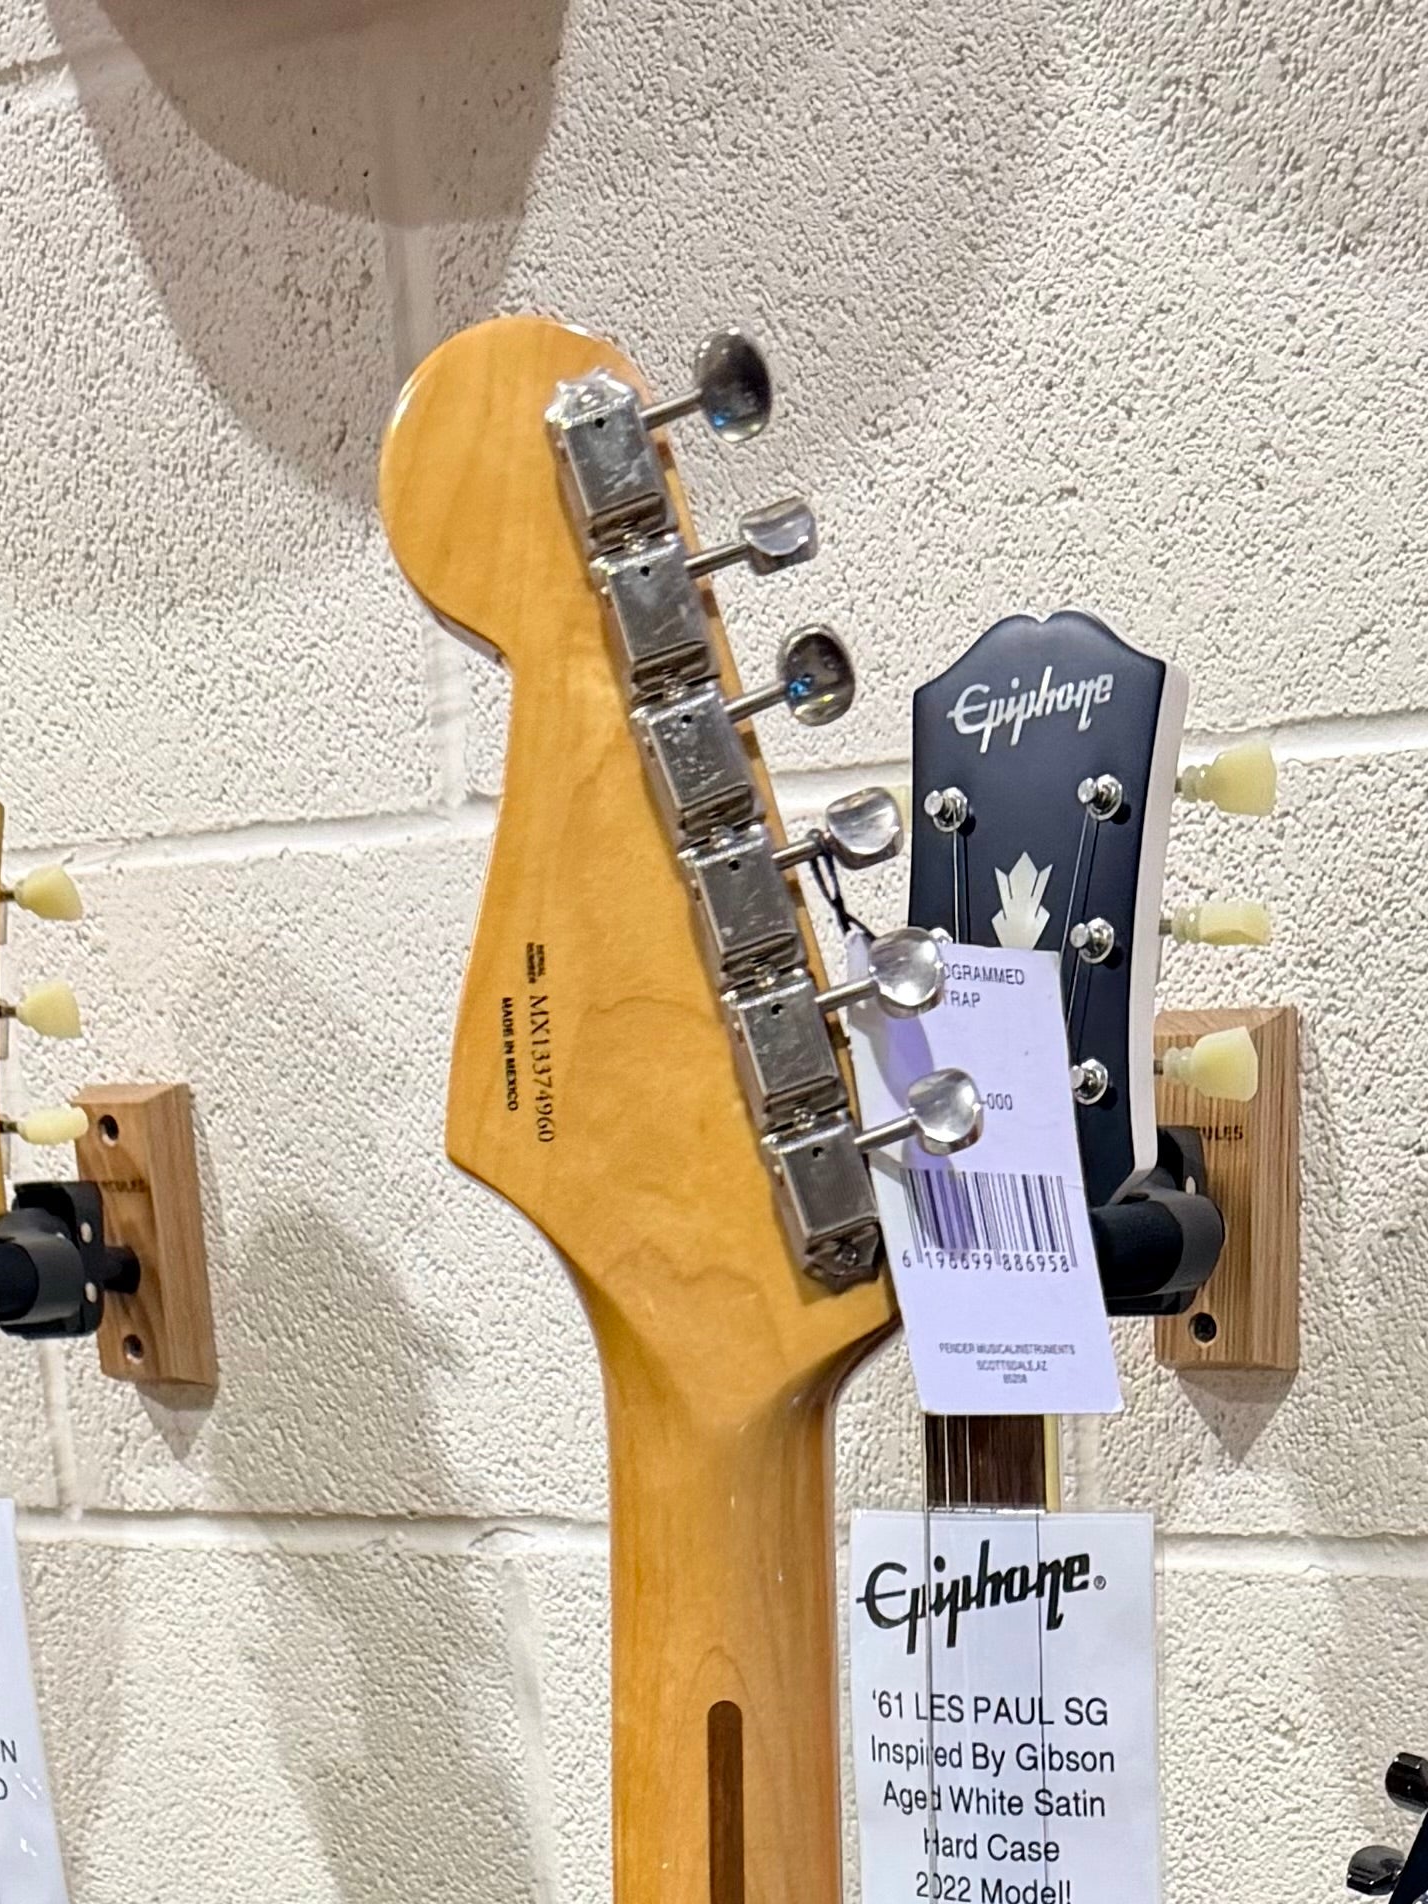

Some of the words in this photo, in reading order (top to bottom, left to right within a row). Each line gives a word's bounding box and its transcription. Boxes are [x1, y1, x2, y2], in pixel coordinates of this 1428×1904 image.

[946, 665, 1114, 754] Epiphone
[502, 997, 514, 1037] MADE
[503, 1041, 515, 1055] IN
[505, 1058, 518, 1112] MEXICO
[529, 995, 555, 1143] MX13374960
[902, 1250, 911, 1268] 6
[915, 1692, 965, 1725] LES
[973, 1695, 1055, 1726] PAUL
[1064, 1697, 1109, 1727] SG
[870, 1735, 964, 1771] Inspired
[971, 1742, 1006, 1778] By
[1015, 1742, 1115, 1774] Gibson
[883, 1780, 943, 1818] Aged
[948, 1786, 1024, 1818] White
[1035, 1788, 1106, 1820] Satin
[924, 1827, 978, 1862] Hard
[987, 1832, 1061, 1864] Case
[916, 1871, 972, 1904] 2022
